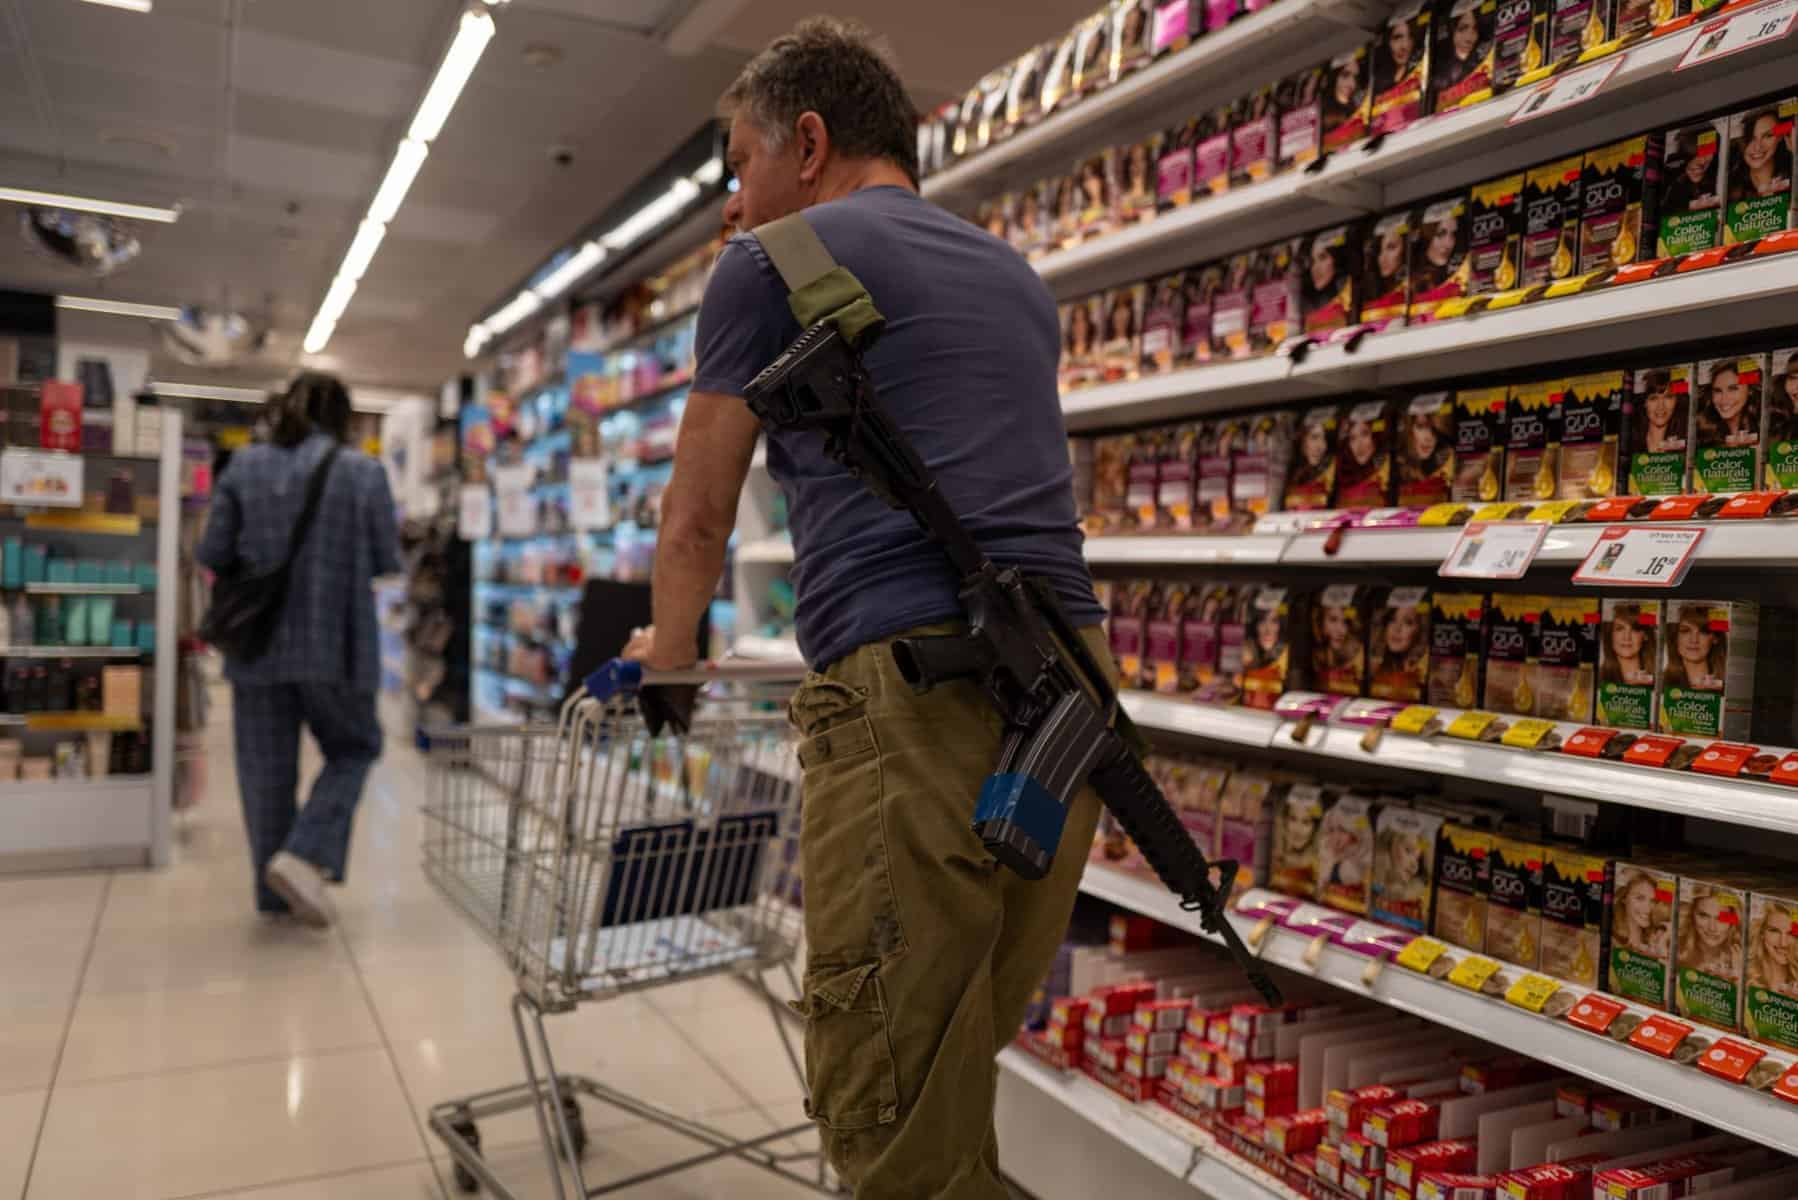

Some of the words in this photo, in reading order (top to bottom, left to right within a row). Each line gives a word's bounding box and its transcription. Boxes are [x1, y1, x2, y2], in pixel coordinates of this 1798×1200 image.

[1742, 209, 1775, 223] Color
[1674, 223, 1705, 236] Color
[1711, 459, 1744, 470] Color
[1643, 557, 1668, 575] 16
[1676, 700, 1708, 711] Color
[1692, 982, 1723, 999] Color
[1762, 1003, 1795, 1020] Color
